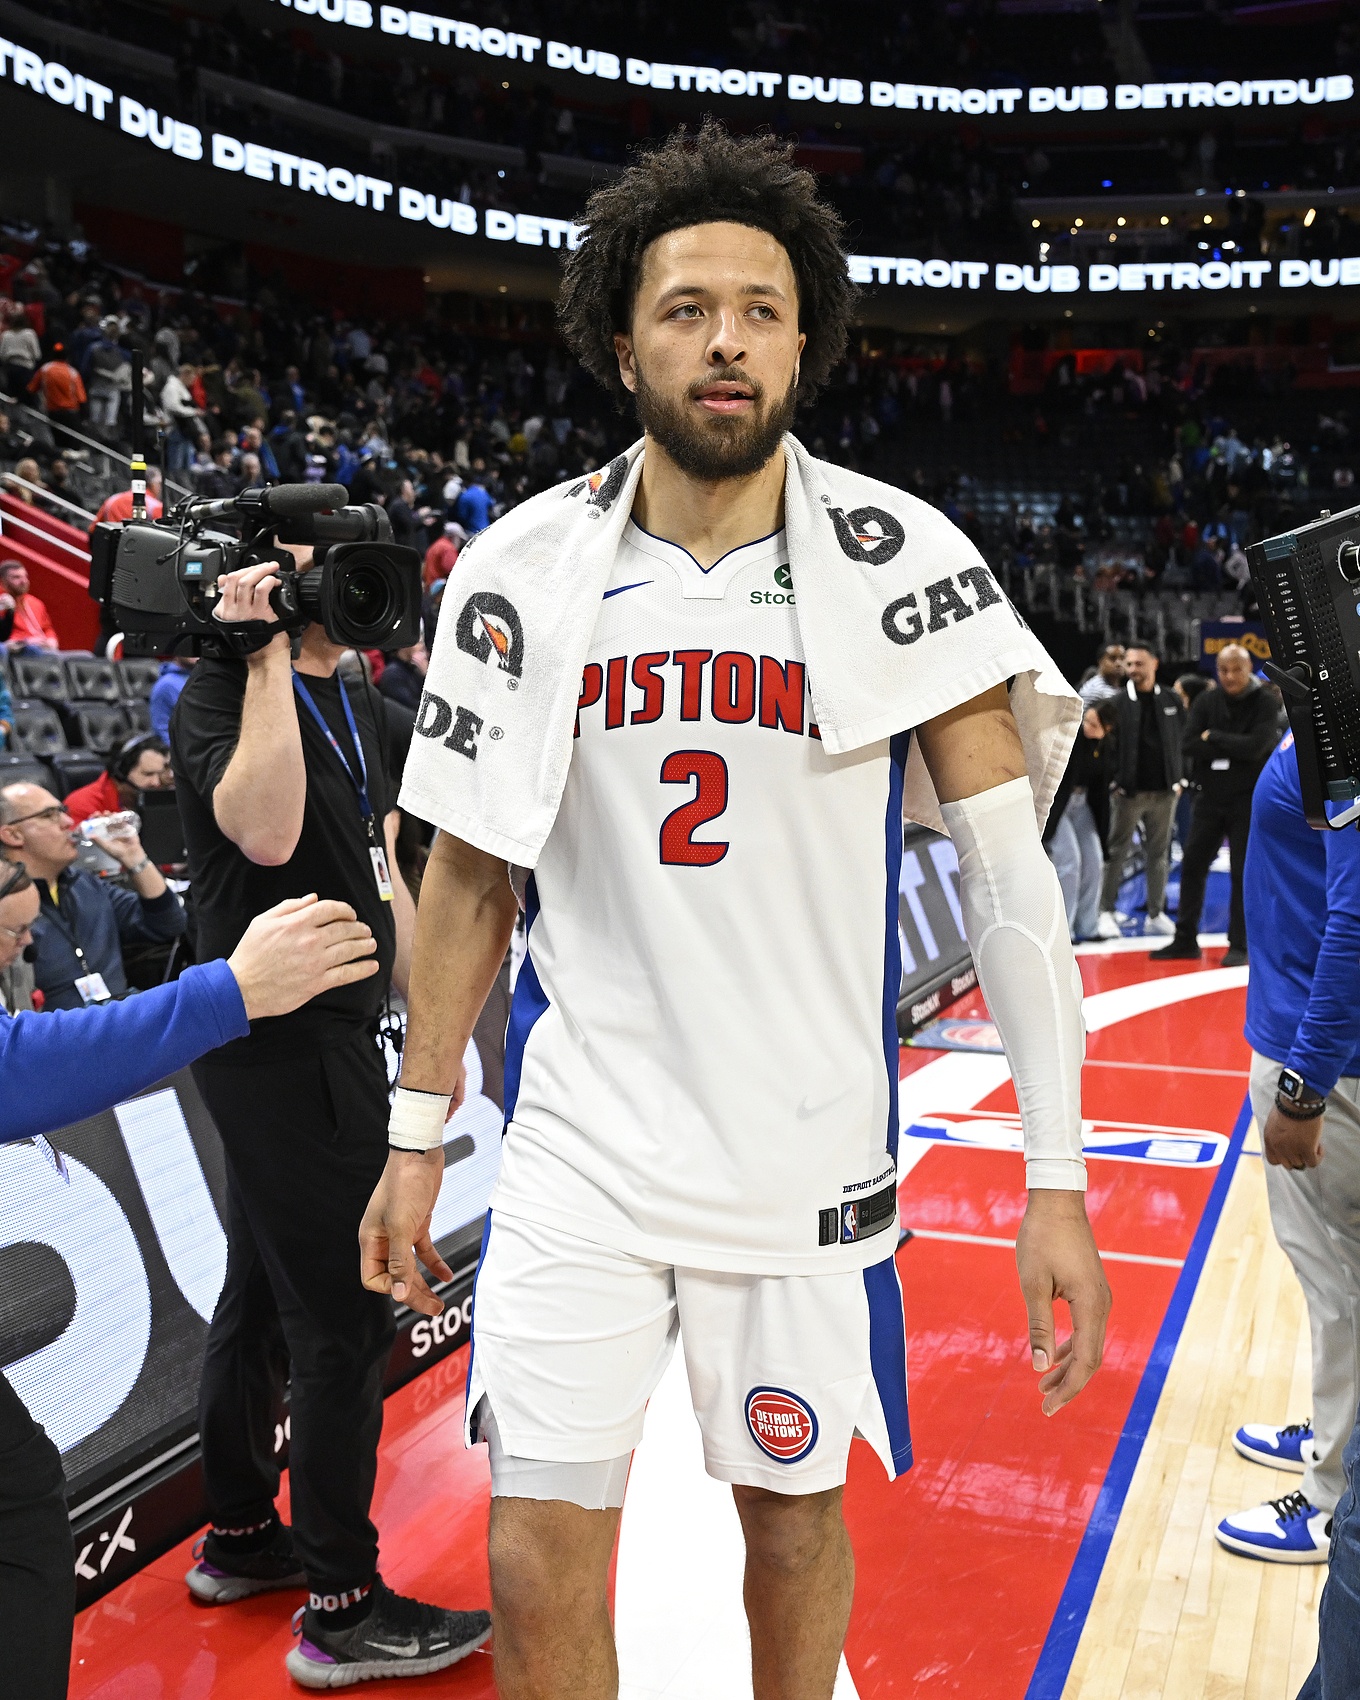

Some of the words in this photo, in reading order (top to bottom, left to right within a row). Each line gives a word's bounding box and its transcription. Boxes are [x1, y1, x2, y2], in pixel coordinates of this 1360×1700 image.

[380, 5, 541, 62] DETROIT
[547, 41, 620, 79] DUB
[626, 58, 782, 98] DETROIT
[788, 74, 864, 105] DUB
[870, 81, 1023, 114] DETROIT
[1028, 85, 1108, 113] DUB
[119, 95, 203, 160] DUB
[212, 133, 393, 211] DETROIT
[399, 186, 478, 235] DUB
[995, 263, 1081, 293] DUB
[1088, 261, 1272, 292] DETROIT
[1279, 257, 1360, 288] DUB
[881, 566, 1031, 645] GAT
[573, 649, 823, 741] PISTON
[659, 750, 730, 867] 2
[842, 1179, 872, 1194] DETROIT
[755, 1408, 800, 1425] DETROIT
[757, 1421, 803, 1438] PISTONS
